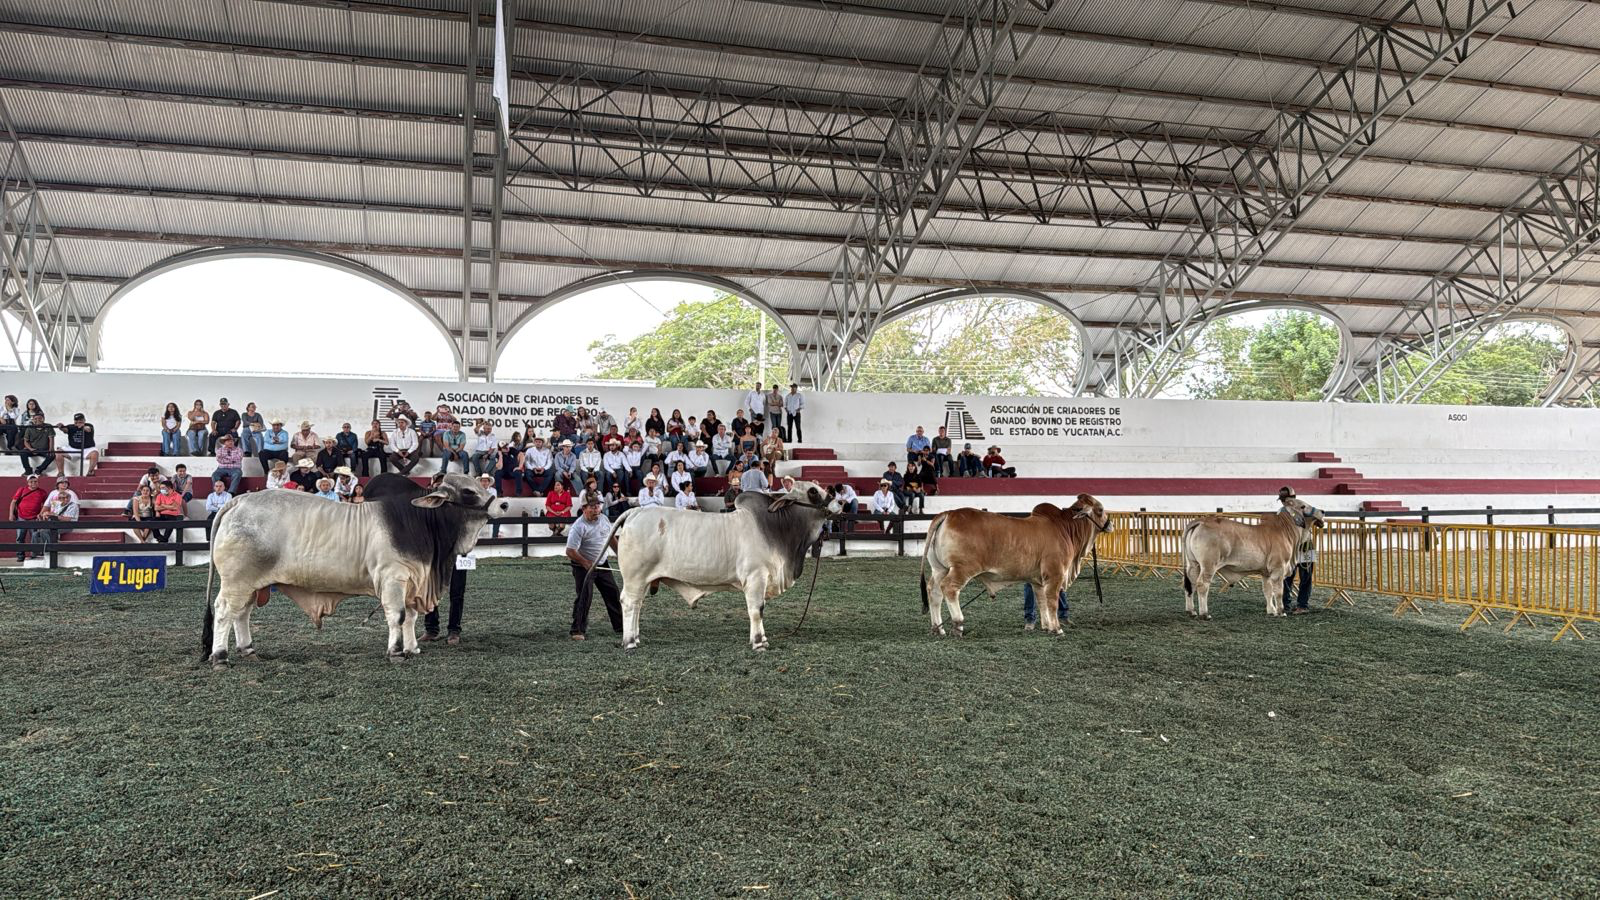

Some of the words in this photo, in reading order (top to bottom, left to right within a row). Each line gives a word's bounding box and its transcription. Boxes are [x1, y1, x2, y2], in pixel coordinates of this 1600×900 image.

[437, 391, 503, 403] ASOCIACIÓN
[506, 394, 520, 404] DE
[523, 395, 582, 405] CRIADORES
[586, 396, 599, 406] DE
[449, 405, 486, 415] NADO
[489, 406, 528, 416] BOVINO
[530, 407, 544, 416] DE
[990, 403, 1040, 414] ASOCIACIÓN
[1043, 406, 1054, 414] DE
[1057, 406, 1106, 415] CRIADORES
[1109, 407, 1120, 415] DE
[990, 416, 1026, 425] GANADO
[1032, 417, 1063, 425] BOVINO
[1065, 417, 1077, 425] DE
[1080, 417, 1122, 426] REGISTRO
[1448, 413, 1468, 421] ASOCI
[460, 418, 502, 428] ESDO
[504, 419, 519, 428] DE
[990, 427, 1004, 436] DEL
[1009, 427, 1045, 436] ESTADO
[1047, 428, 1059, 436] DE
[119, 563, 160, 590] Lugar
